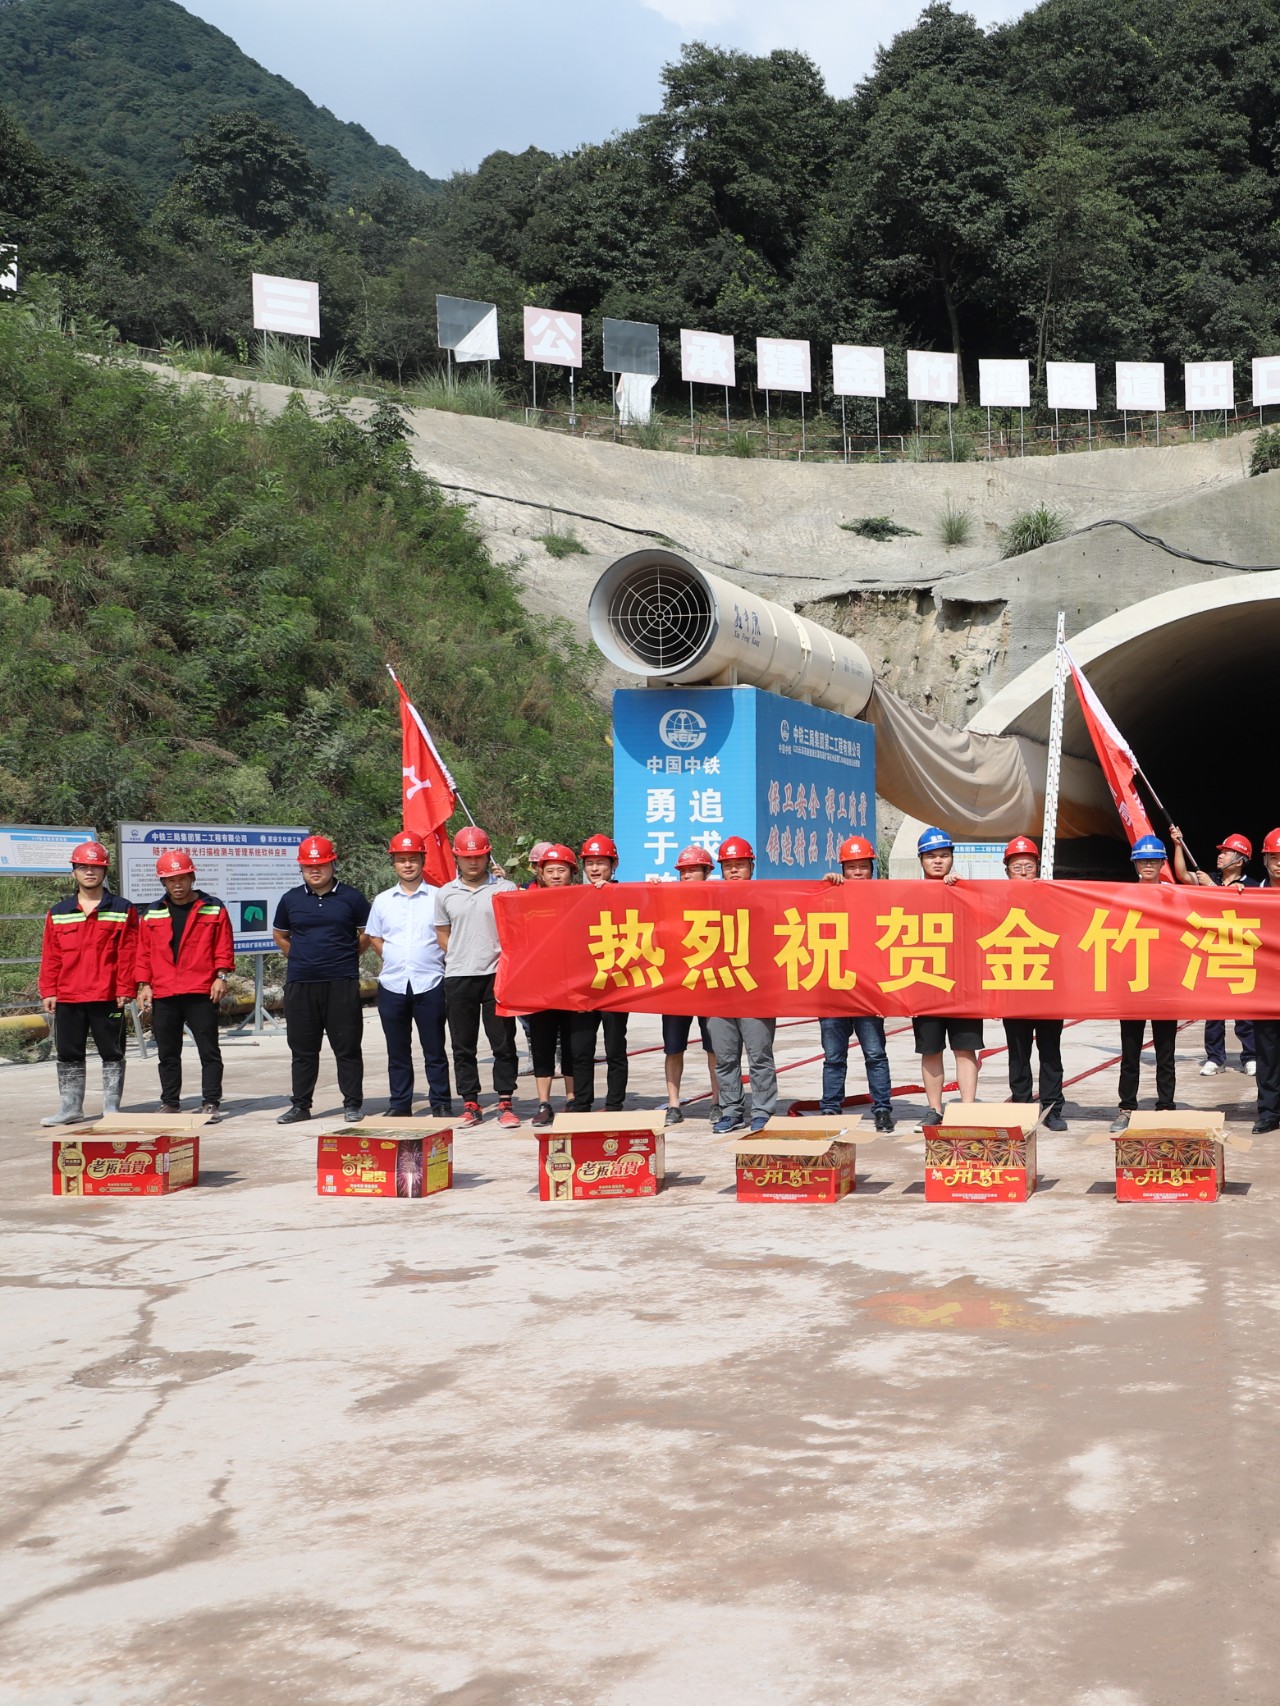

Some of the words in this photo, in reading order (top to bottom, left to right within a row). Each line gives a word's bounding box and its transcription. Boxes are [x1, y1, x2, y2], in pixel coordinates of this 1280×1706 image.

[528, 314, 577, 359] 公
[793, 724, 861, 759] 中铁三局集团第二工程有限公司
[647, 755, 721, 775] 中国中铁
[768, 780, 820, 820] 保卫安全
[151, 832, 247, 843] 中铁三局集团第二工程有限公司
[644, 788, 679, 881] 勇于
[689, 788, 724, 881] 追求
